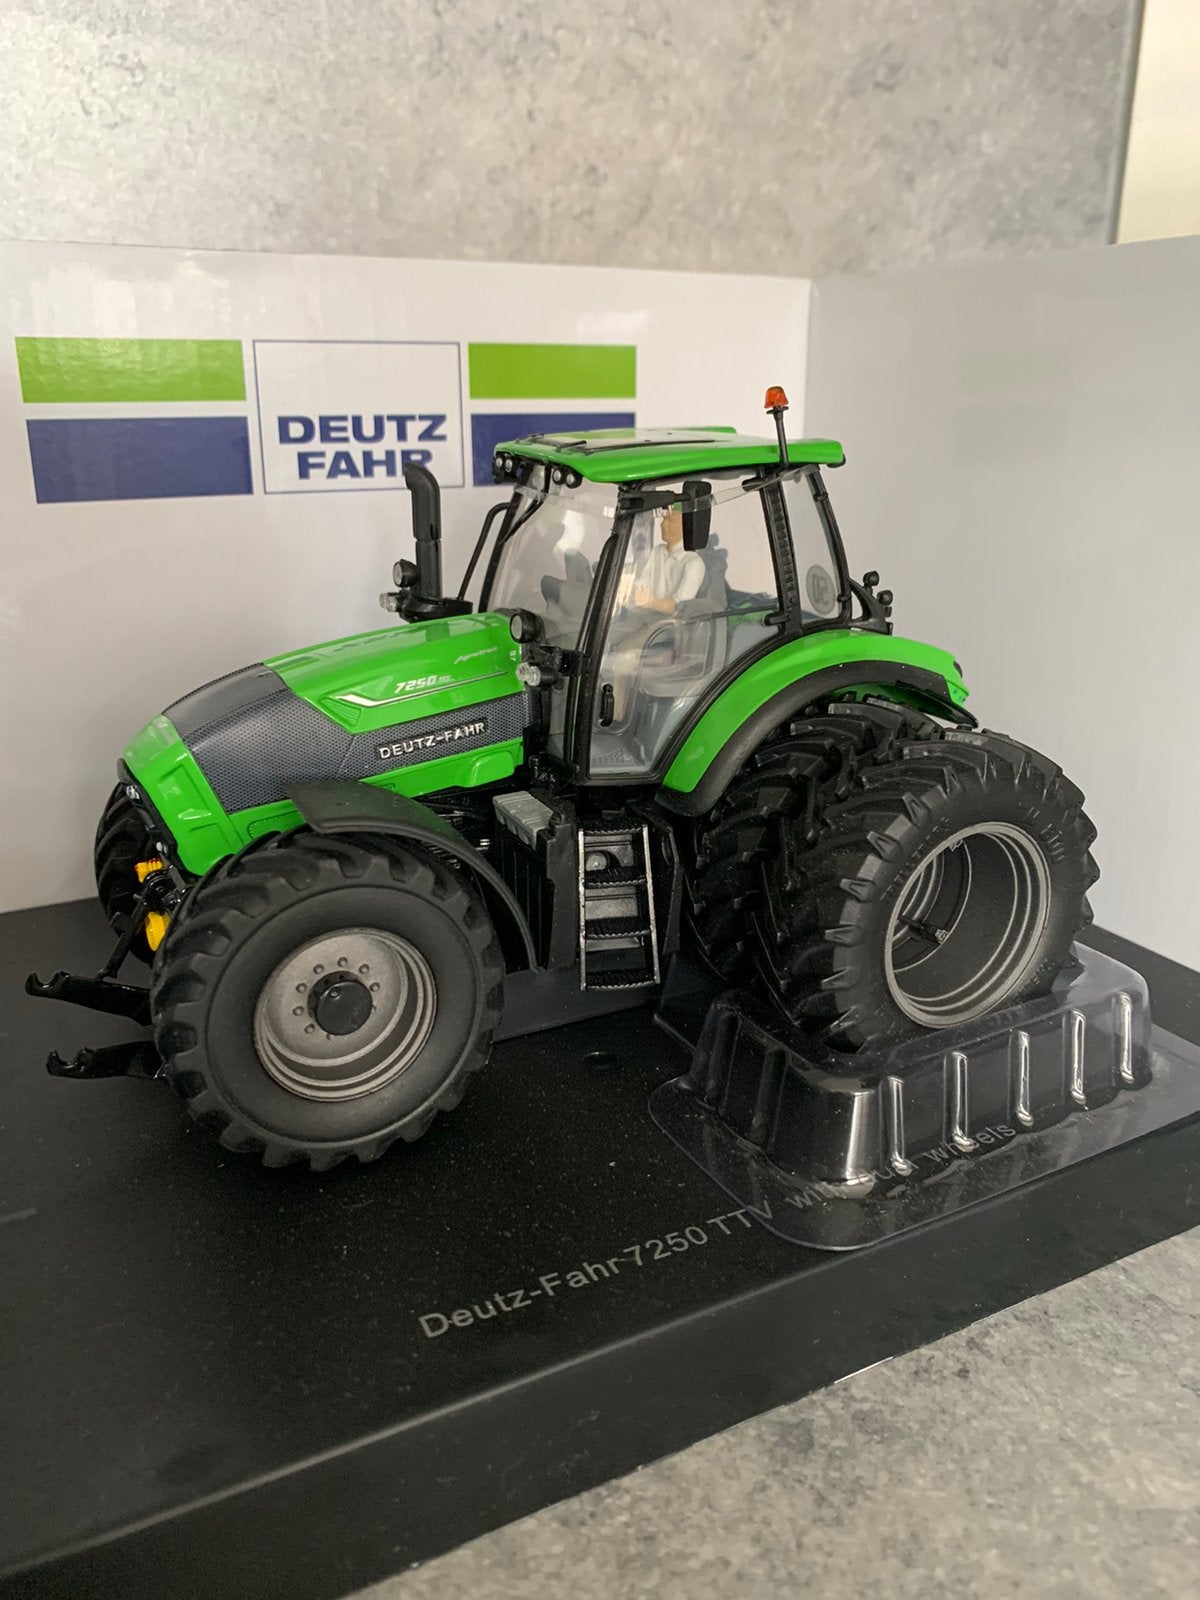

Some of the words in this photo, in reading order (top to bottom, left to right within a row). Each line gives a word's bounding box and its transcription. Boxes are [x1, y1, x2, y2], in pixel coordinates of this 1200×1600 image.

[277, 414, 447, 445] DEUTZ
[297, 448, 434, 480] FAHR
[394, 674, 437, 694] 7250
[379, 722, 485, 759] DEUTZ-FAHR
[419, 1257, 624, 1338] Deutz-Fahr
[622, 1226, 709, 1267] 7250
[706, 1200, 774, 1235] TTV
